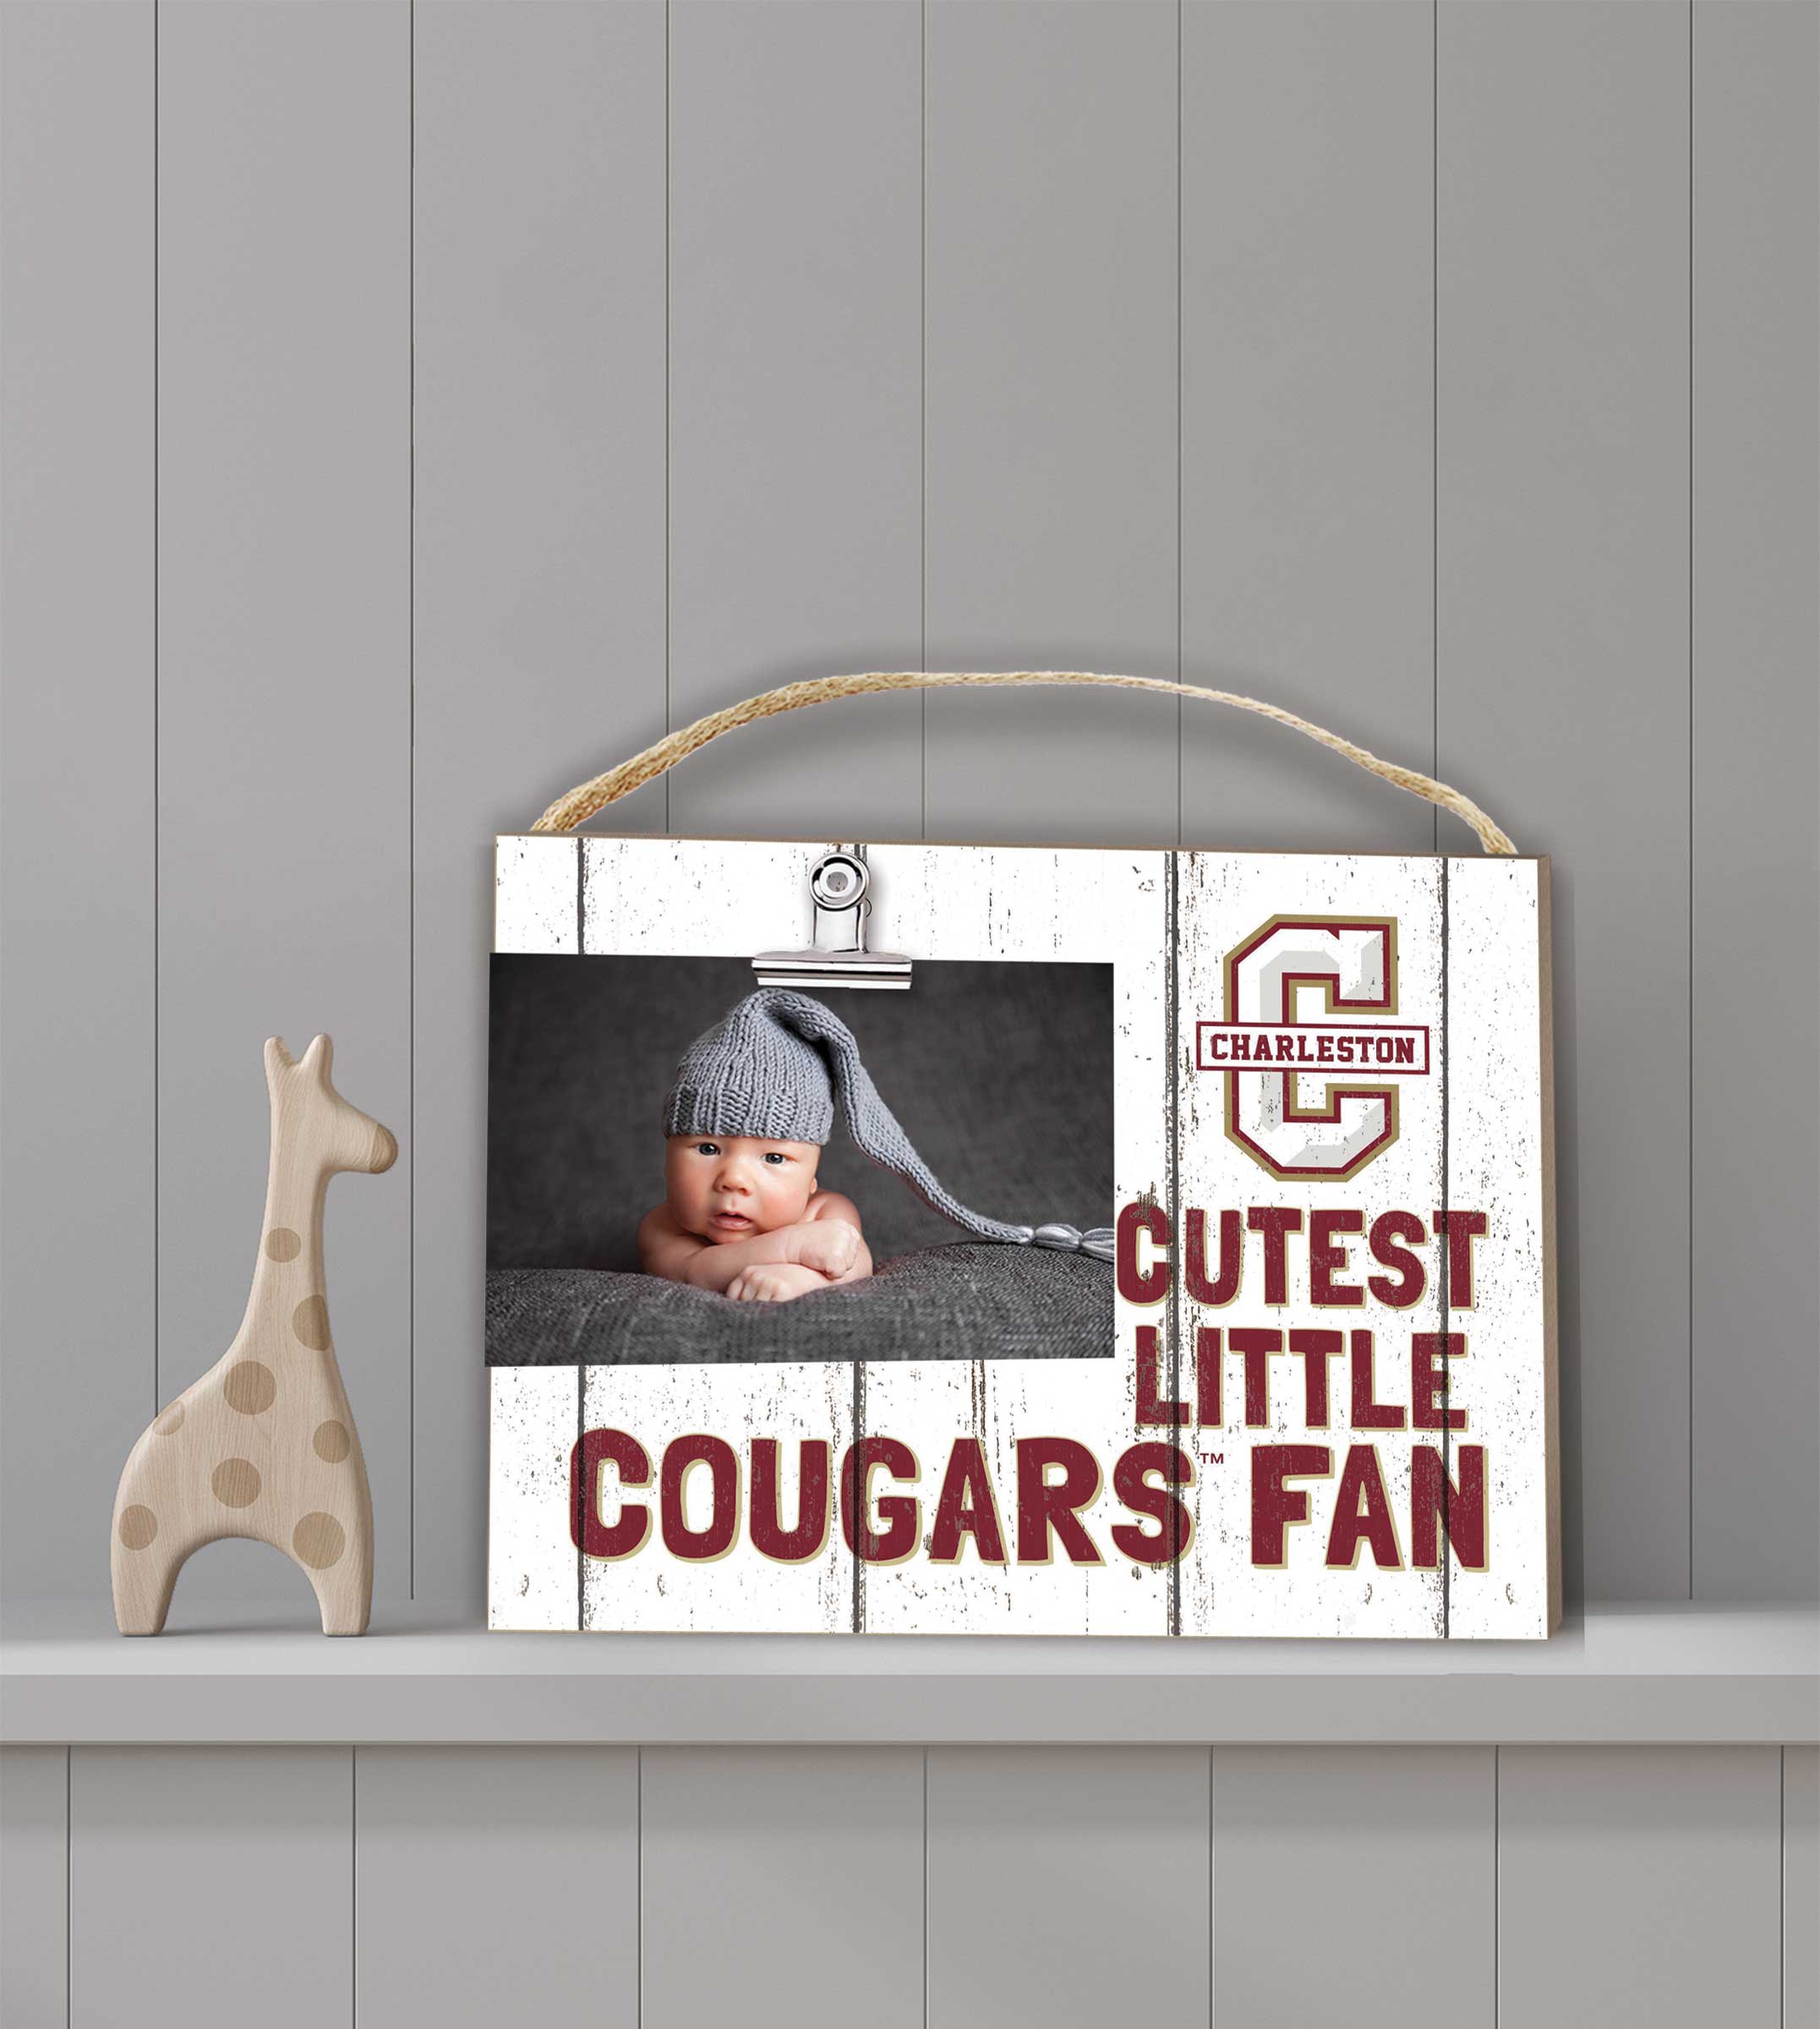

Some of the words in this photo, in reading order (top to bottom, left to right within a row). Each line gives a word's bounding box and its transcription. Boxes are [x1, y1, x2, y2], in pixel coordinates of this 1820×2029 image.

[1211, 1033, 1415, 1064] CHARLESTON
[1116, 1201, 1489, 1310] CUTEST
[1134, 1325, 1468, 1432] LITTLE
[569, 1428, 1196, 1567] COUGARS
[1251, 1444, 1489, 1572] FAN
